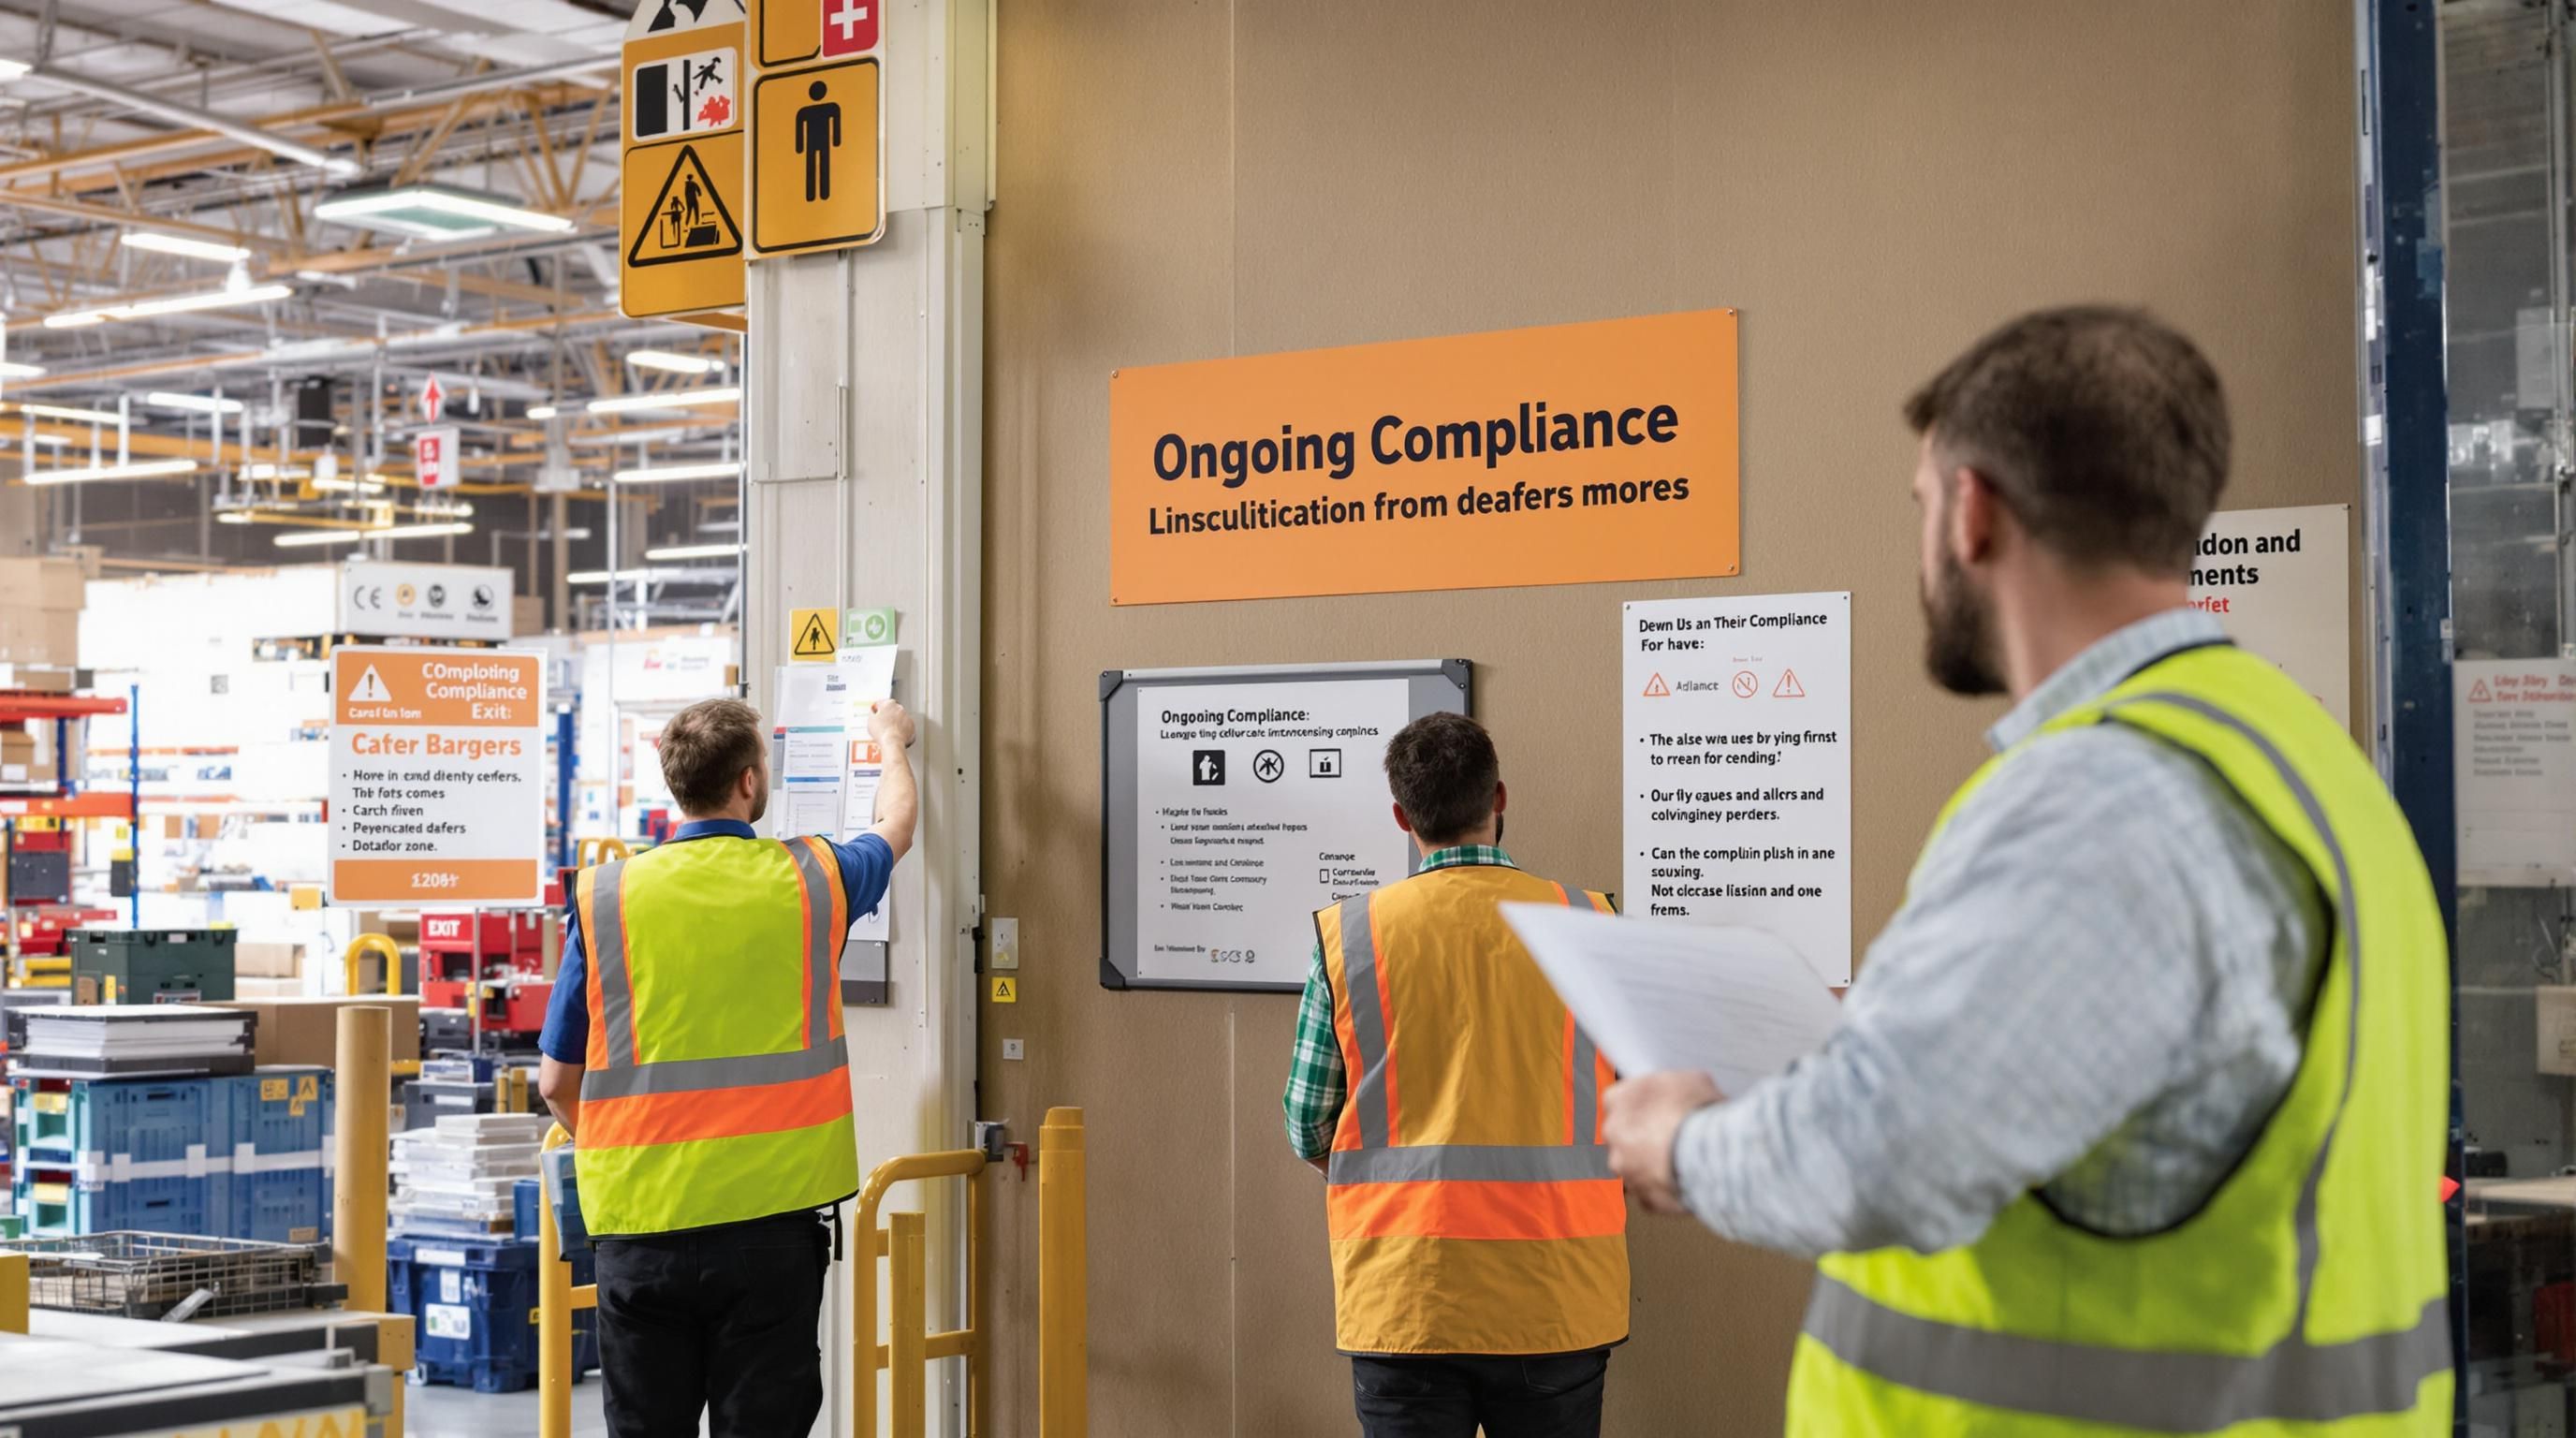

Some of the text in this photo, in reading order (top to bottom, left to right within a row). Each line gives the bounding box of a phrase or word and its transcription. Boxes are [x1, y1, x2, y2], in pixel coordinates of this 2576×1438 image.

[1153, 402, 1678, 488] Ongoing Compliance
[1149, 497, 1365, 535] Linsculitication
[1374, 492, 1448, 521] from
[1456, 481, 1573, 515] deafers
[2255, 528, 2301, 554] and
[1639, 613, 1828, 633] Dewn Us an Their Compliance
[1641, 638, 1705, 652] For have:
[426, 682, 527, 701] Compliance
[1227, 708, 1310, 725] Compliance:
[351, 732, 522, 760] Cafer Bargers
[1649, 733, 1674, 746] The
[1676, 732, 1703, 745] alse
[1650, 754, 1663, 766] to
[1704, 751, 1722, 764] for
[405, 789, 446, 800] comes
[1650, 788, 1675, 801] Our
[1736, 787, 1760, 801] and
[1800, 787, 1824, 800] and
[1651, 847, 1676, 860] Can
[1679, 847, 1700, 859] the
[1797, 846, 1808, 859] in
[1812, 848, 1836, 859] ane
[1651, 885, 1674, 897] Not
[1770, 884, 1794, 897] and
[1650, 903, 1690, 916] frems.
[428, 919, 461, 937] EXIT
